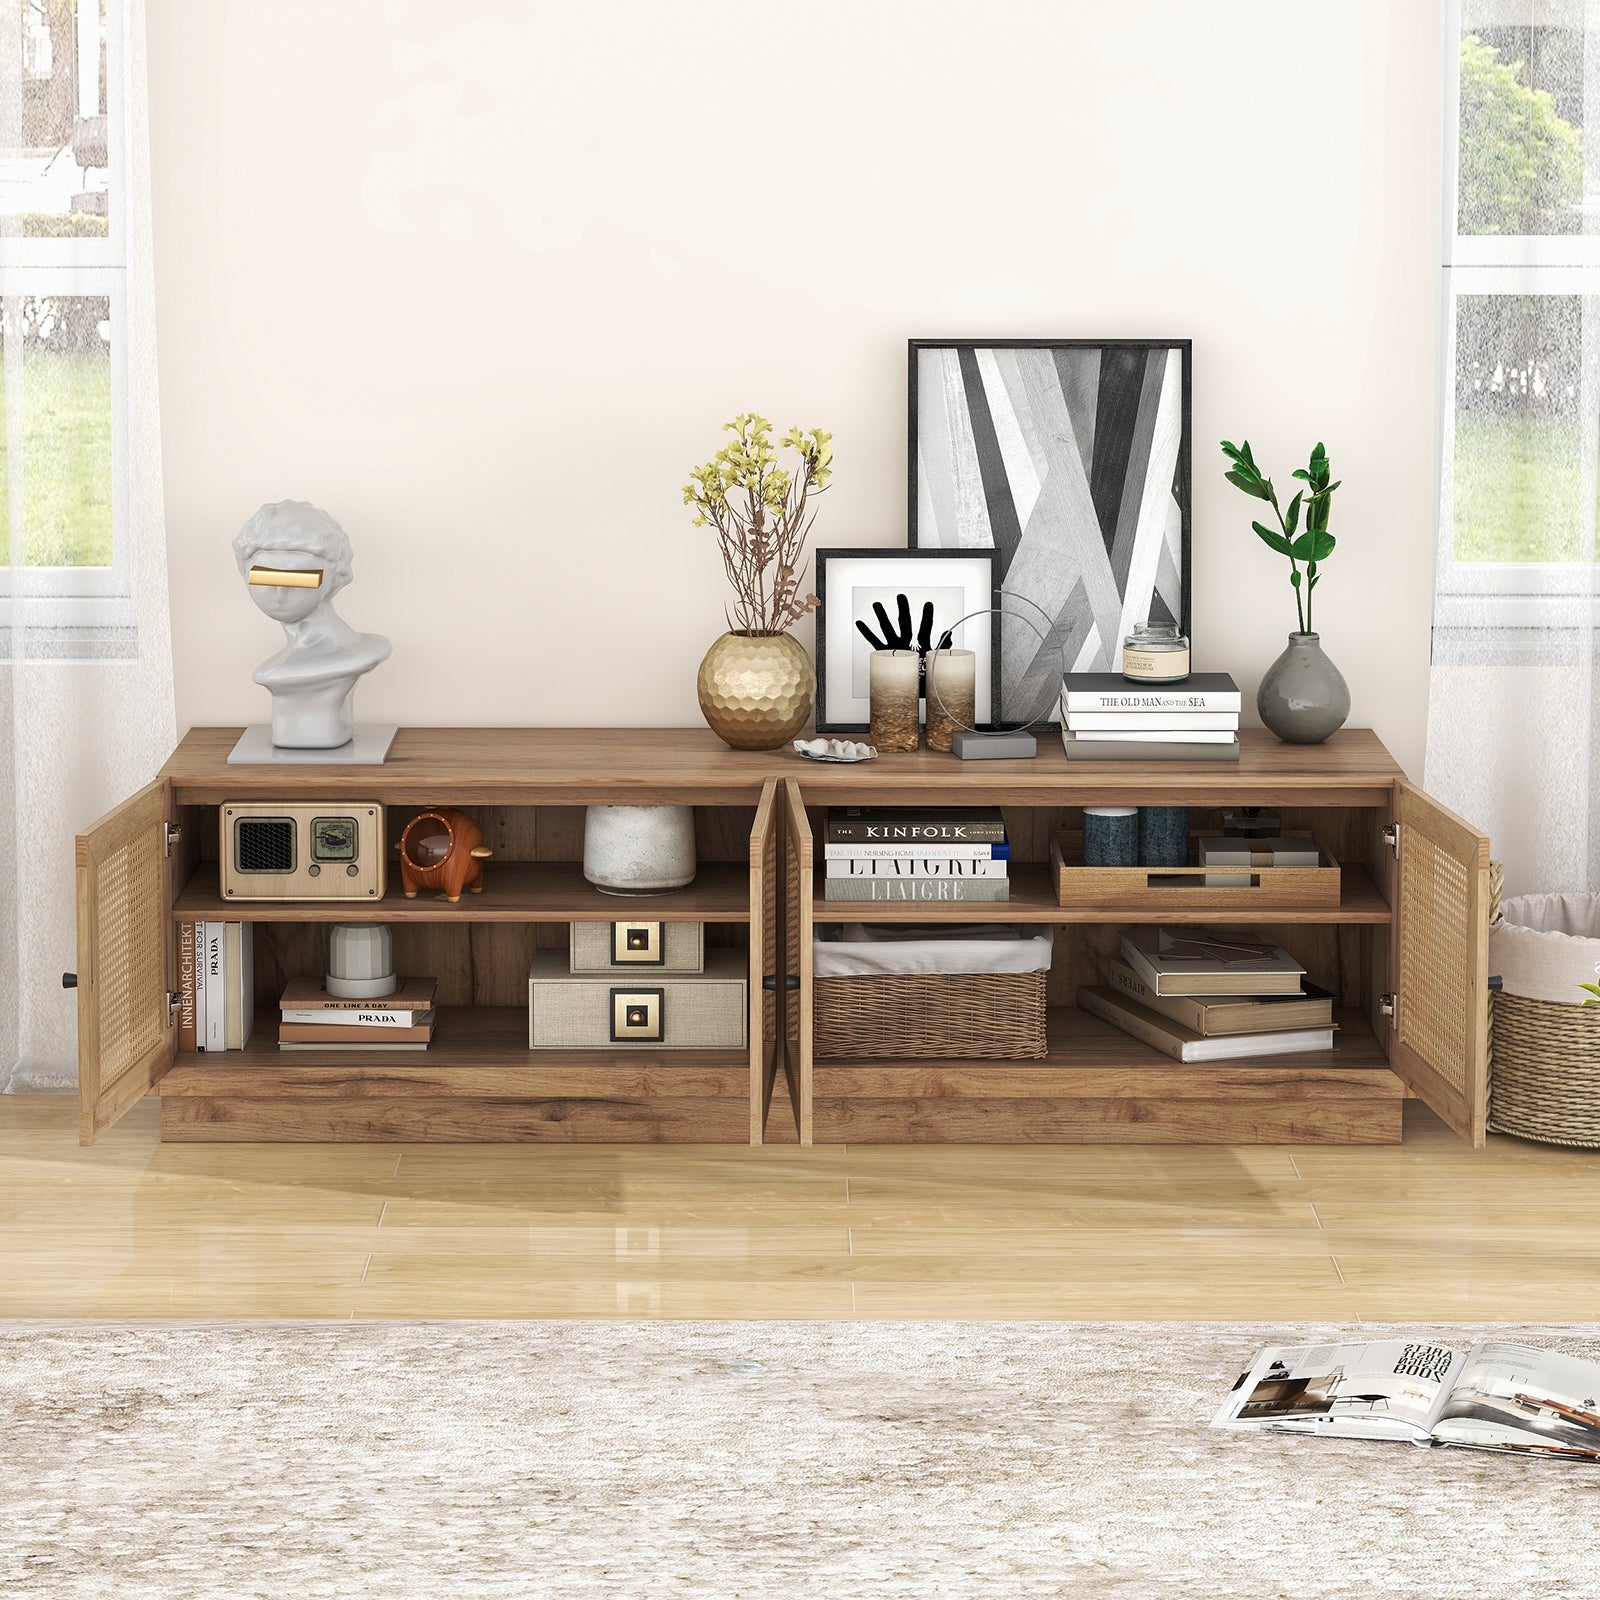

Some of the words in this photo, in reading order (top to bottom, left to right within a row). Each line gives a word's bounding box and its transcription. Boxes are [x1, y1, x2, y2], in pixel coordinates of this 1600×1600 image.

[1099, 697, 1120, 707] THE
[1120, 697, 1140, 707] OLD
[1141, 697, 1162, 707] MAN
[1162, 699, 1175, 707] AND
[1175, 699, 1188, 707] THE
[1188, 697, 1206, 707] SEA
[866, 826, 968, 838] KINFOLK
[871, 880, 965, 901] LIAIGRE
[210, 937, 219, 976] PRADA
[1118, 974, 1146, 996] RIVERS
[358, 1014, 397, 1023] PRADA
